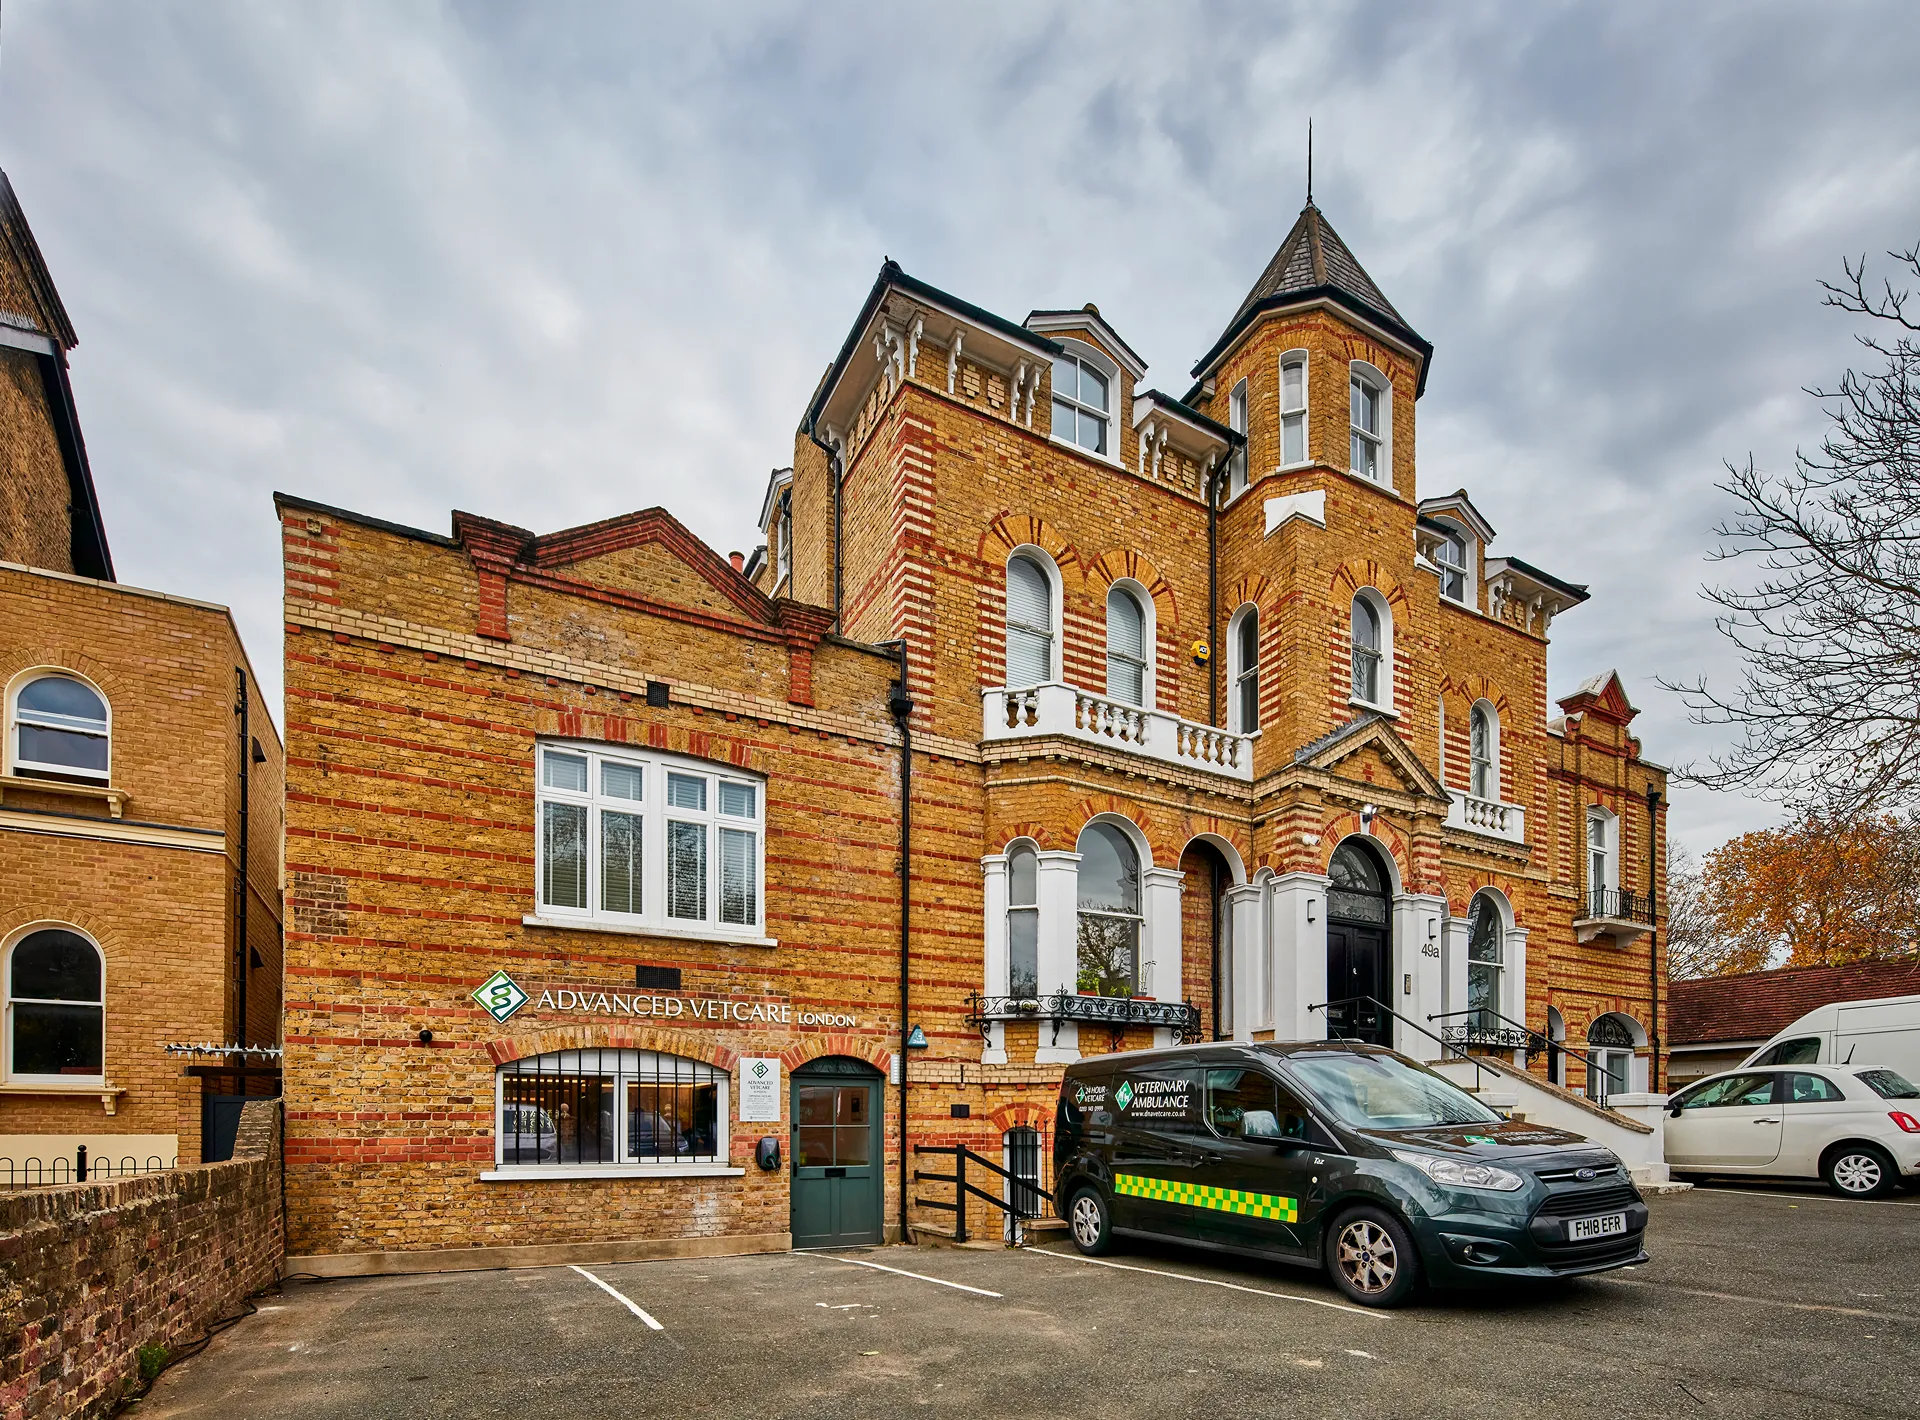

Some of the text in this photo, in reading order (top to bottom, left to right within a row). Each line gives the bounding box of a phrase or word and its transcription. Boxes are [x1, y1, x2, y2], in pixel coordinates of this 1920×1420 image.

[1421, 943, 1440, 958] 49a
[537, 989, 857, 1028] ADVANCED VETCARE LONDON
[1091, 1085, 1106, 1094] HOUR
[1134, 1079, 1190, 1094] VETERINARY
[1084, 1094, 1105, 1102] VETCARE
[1132, 1095, 1189, 1108] AMBULANCE
[1575, 1215, 1622, 1238] FH18 EFR
